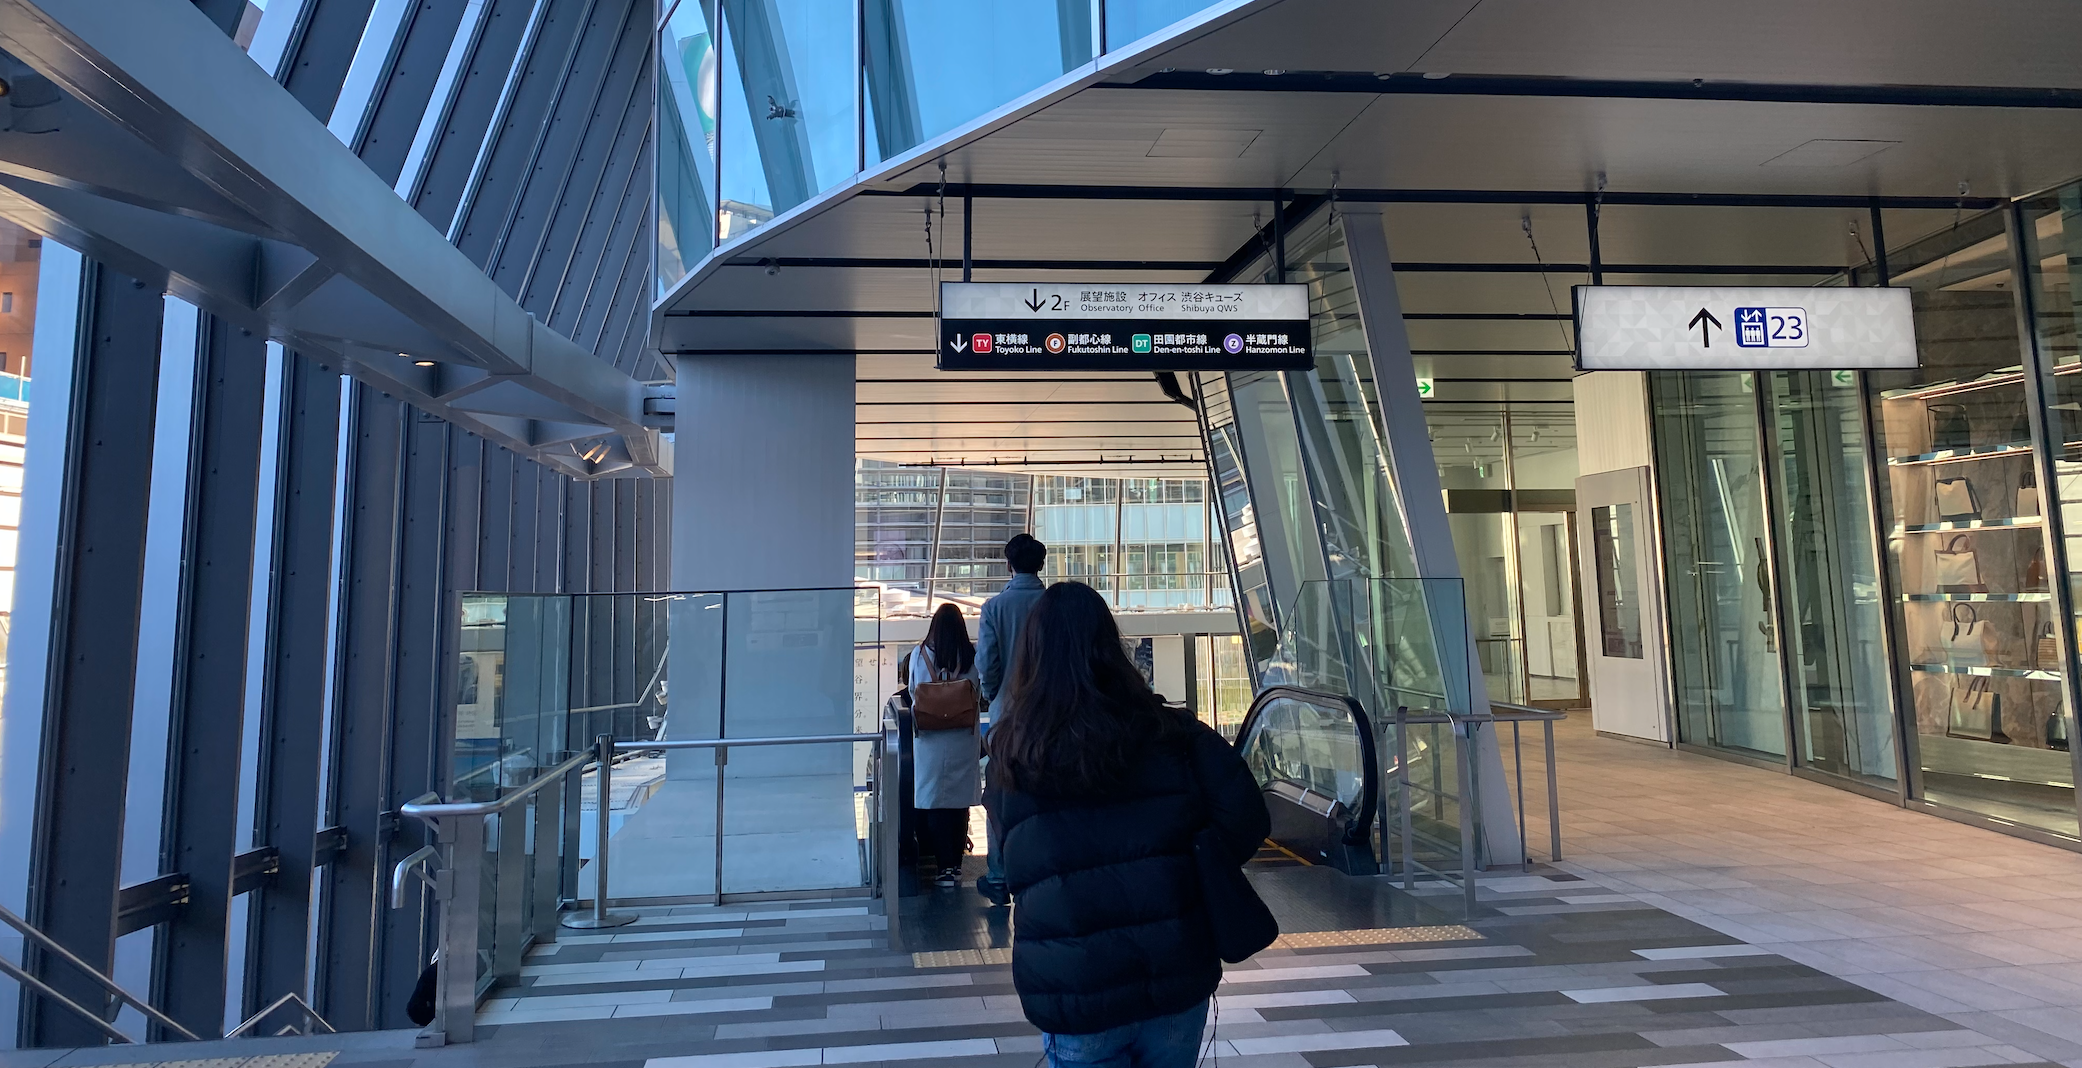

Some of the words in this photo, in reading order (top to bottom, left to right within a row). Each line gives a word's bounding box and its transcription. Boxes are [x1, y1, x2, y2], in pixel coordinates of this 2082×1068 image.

[1079, 291, 1127, 303] 展望施設
[1138, 291, 1177, 303] オフィス
[1181, 291, 1243, 303] 渋谷キューズ
[1051, 294, 1070, 311] 2F
[1080, 303, 1134, 313] Observatory
[1138, 303, 1165, 312] Office
[1181, 303, 1215, 313] Shibuya
[1216, 303, 1239, 313] QWS
[1770, 315, 1804, 340] 23
[975, 338, 990, 348] TY
[995, 334, 1029, 345] 東横線
[1067, 334, 1112, 345] 副都心線
[1135, 339, 1148, 348] DT
[1153, 334, 1207, 345] 田園都市線
[1246, 334, 1288, 345] 半蔵門線
[995, 346, 1024, 355] Toyoko
[1025, 346, 1043, 354] Line
[1067, 346, 1111, 354] Fukutoshin
[1111, 346, 1129, 354] Line
[1153, 346, 1204, 354] Den-en-toshi
[1204, 346, 1221, 354] Line
[1246, 346, 1288, 354] Hanzomon
[1288, 346, 1306, 354] Line
